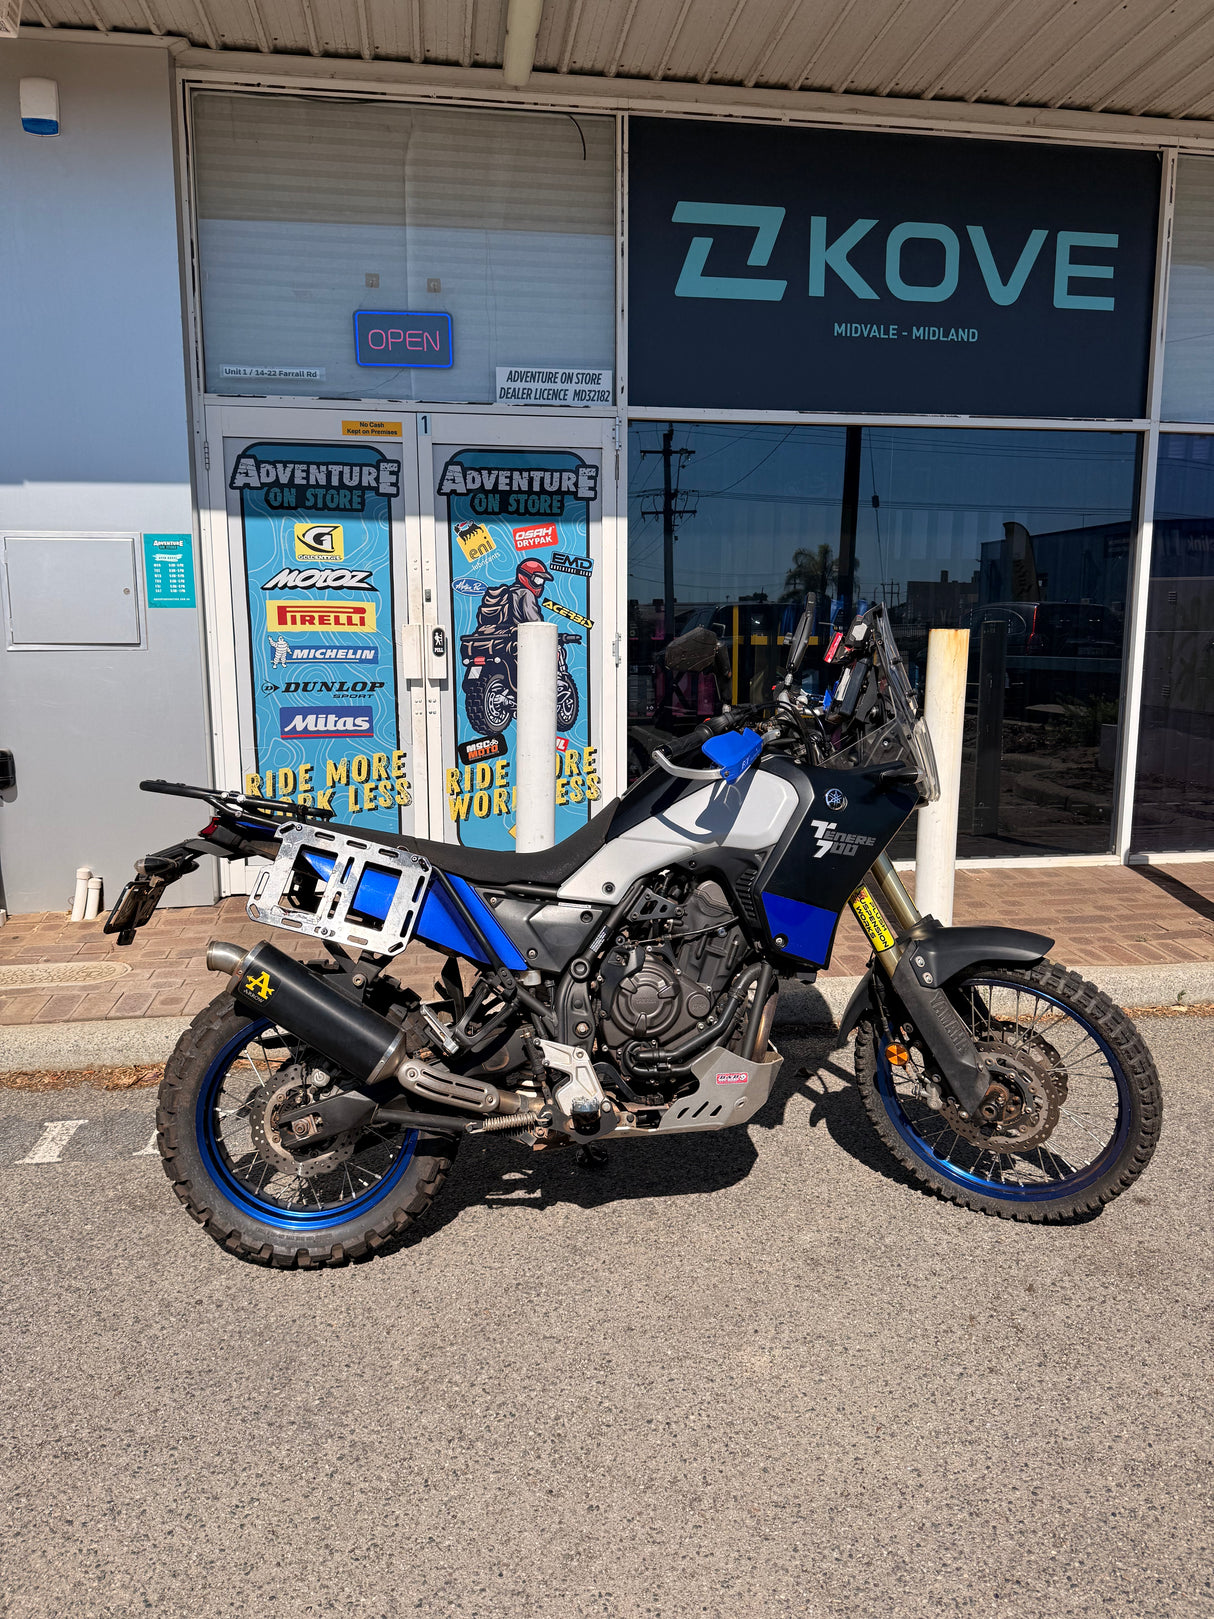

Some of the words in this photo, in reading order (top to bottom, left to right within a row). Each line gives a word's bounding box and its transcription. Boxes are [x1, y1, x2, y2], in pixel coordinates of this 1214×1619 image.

[808, 215, 1119, 312] KOVE
[368, 329, 440, 352] OPEN
[833, 322, 898, 340] MIDVALE
[912, 325, 978, 342] MIDLAND
[224, 368, 242, 376] Unit
[255, 369, 277, 377] 14-22
[506, 370, 559, 384] ADVENTURE
[560, 371, 574, 385] ON
[575, 372, 602, 386] STORE
[499, 387, 533, 400] DEALER
[534, 388, 569, 401] LICENCE
[572, 389, 611, 402] MD32182
[346, 428, 361, 436] Kept
[370, 428, 398, 436] Premises
[421, 415, 428, 434] 1
[232, 457, 398, 495] ADVENTURE
[440, 465, 597, 498] ADVENTURE
[269, 487, 296, 507] ON
[305, 488, 363, 510] STORE
[473, 493, 500, 513] ON
[508, 494, 562, 514] STORE
[469, 536, 494, 560] eni
[516, 535, 553, 548] DRYPAK
[471, 551, 501, 571] lubricants
[551, 552, 593, 570] EMD
[276, 605, 367, 627] PIRELLI
[542, 600, 593, 629] ACERBIS
[291, 648, 375, 660] MICHELIN
[281, 681, 385, 693] DUNLOP
[283, 714, 371, 732] Mitas
[468, 744, 499, 760] MOTO
[245, 764, 313, 798] RIDE
[326, 750, 406, 787] MORE
[446, 760, 508, 794] RIDE
[348, 778, 411, 812] LESS
[556, 773, 600, 805] ESS
[813, 839, 860, 859] 700
[855, 905, 877, 940] WORKS
[869, 902, 888, 932] PLUSH
[243, 989, 265, 1003] ARROW
[928, 993, 968, 1054] YAMAHA
